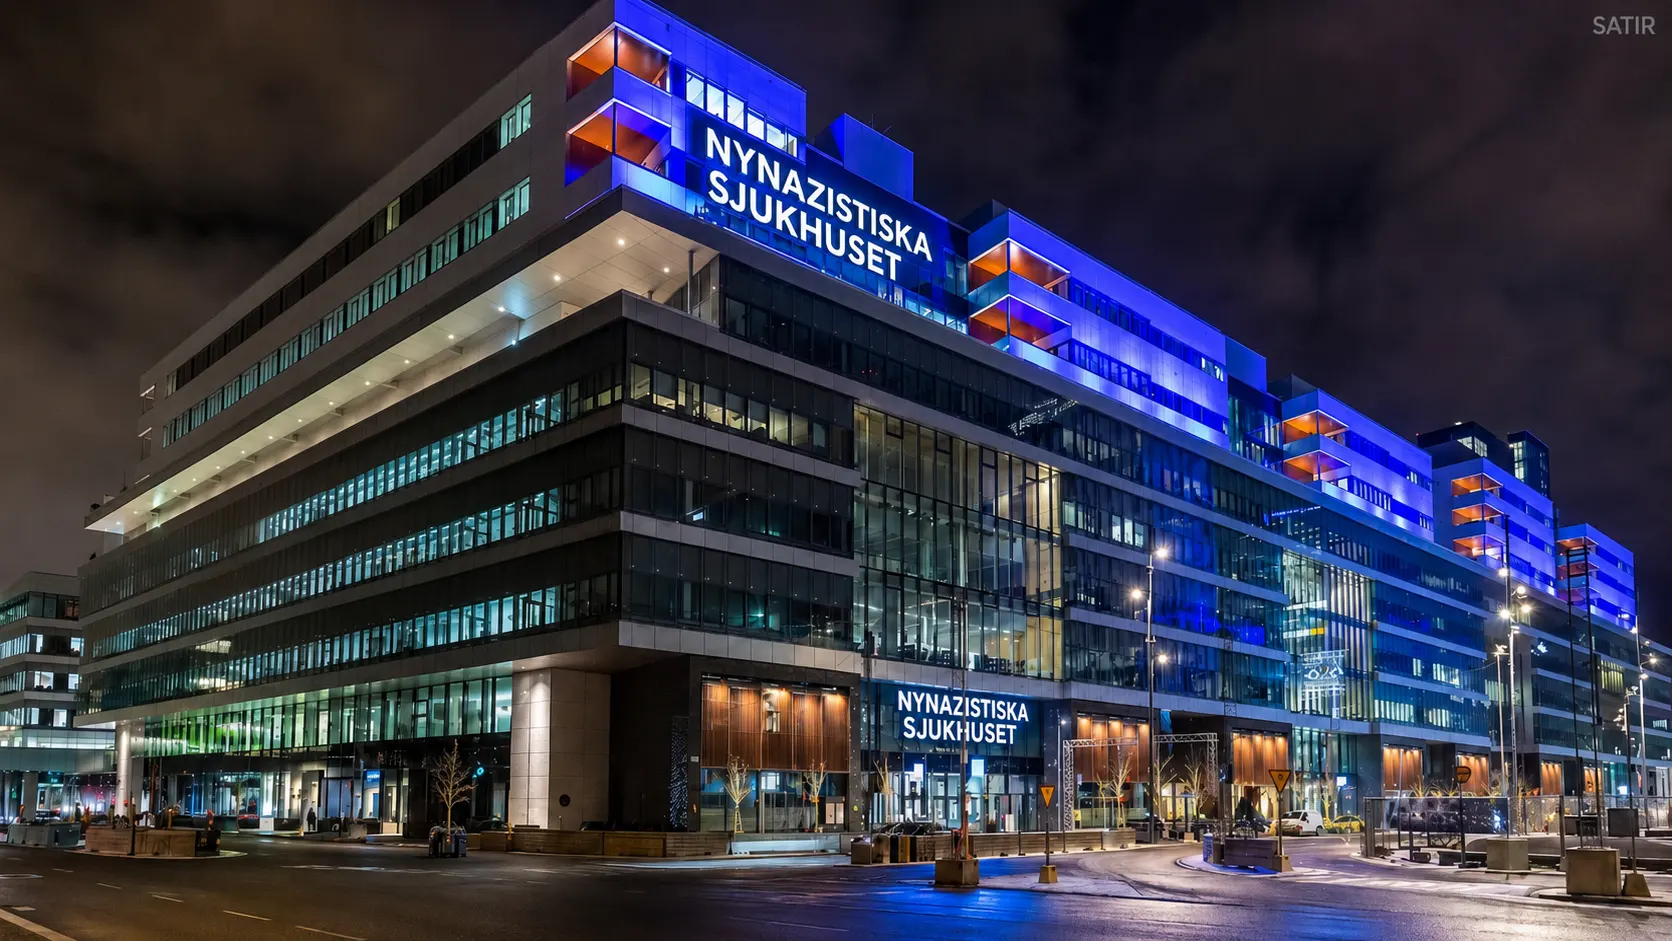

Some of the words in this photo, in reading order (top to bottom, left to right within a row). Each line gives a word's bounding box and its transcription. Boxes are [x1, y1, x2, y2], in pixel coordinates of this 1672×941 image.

[706, 127, 933, 262] NYNAZISTISKA
[708, 170, 902, 281] SJUKHUSET
[897, 690, 1029, 722] NYNAZISTISKA
[903, 716, 1017, 745] SJUKHUSET
